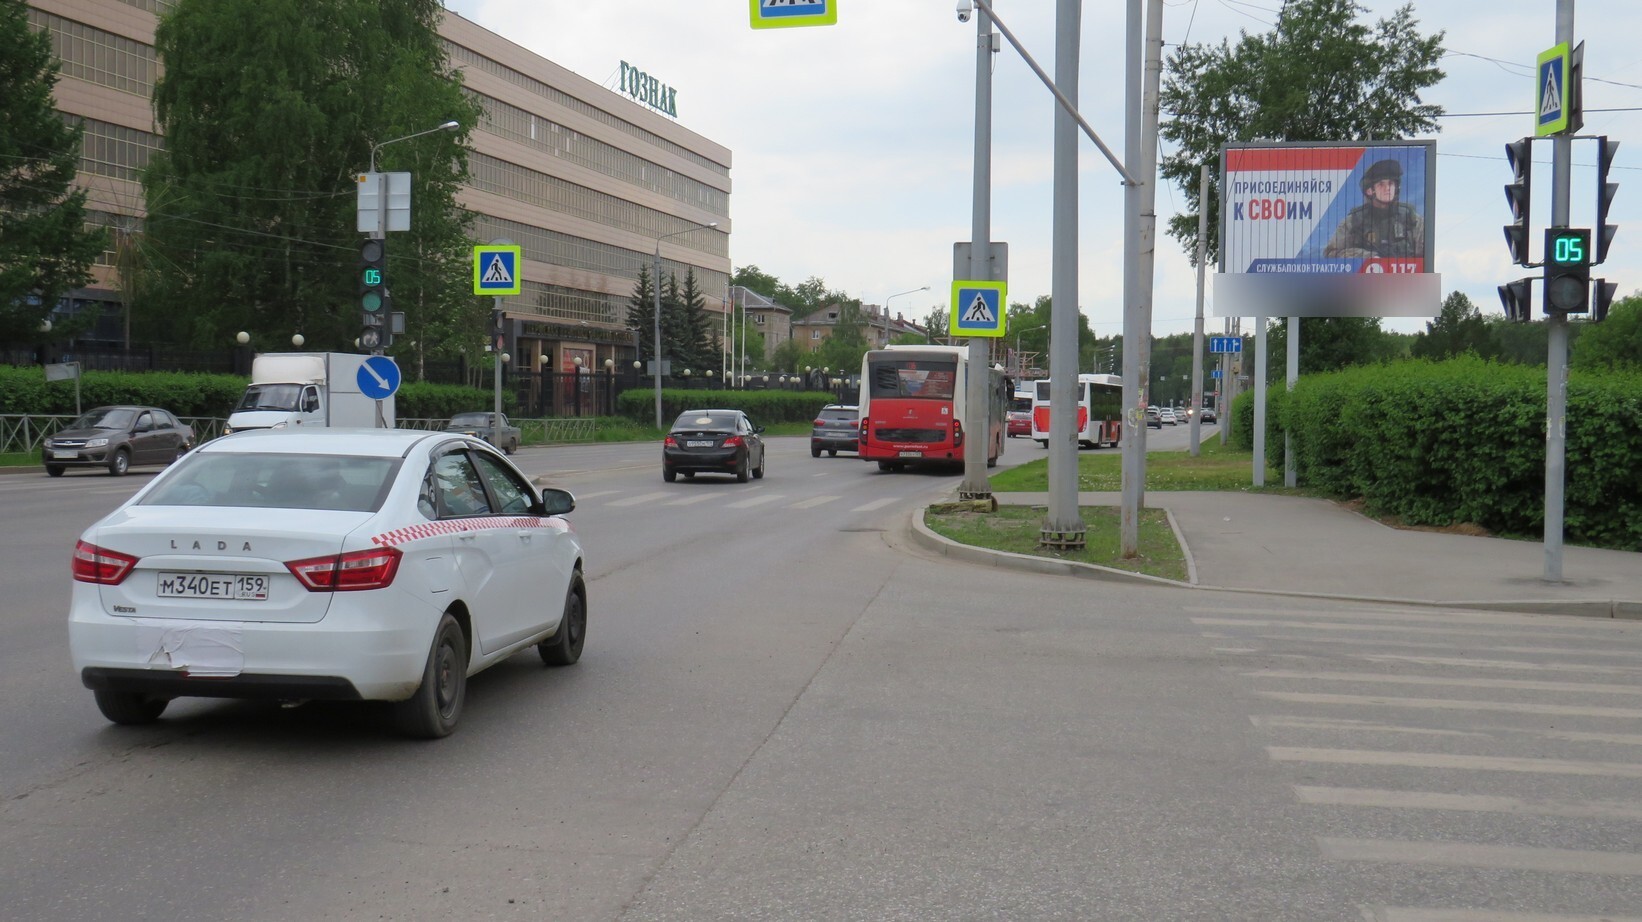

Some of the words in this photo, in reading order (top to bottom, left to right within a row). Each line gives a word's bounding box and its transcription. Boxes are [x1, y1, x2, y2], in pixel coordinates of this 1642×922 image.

[620, 59, 678, 118] ГОЗНАК
[1234, 178, 1332, 195] ПРИСОЕДИНЯЙСЯ
[1234, 202, 1244, 220] К
[1555, 238, 1582, 261] 05
[365, 270, 381, 284] 05
[170, 539, 252, 552] LADA
[237, 577, 264, 592] 159
